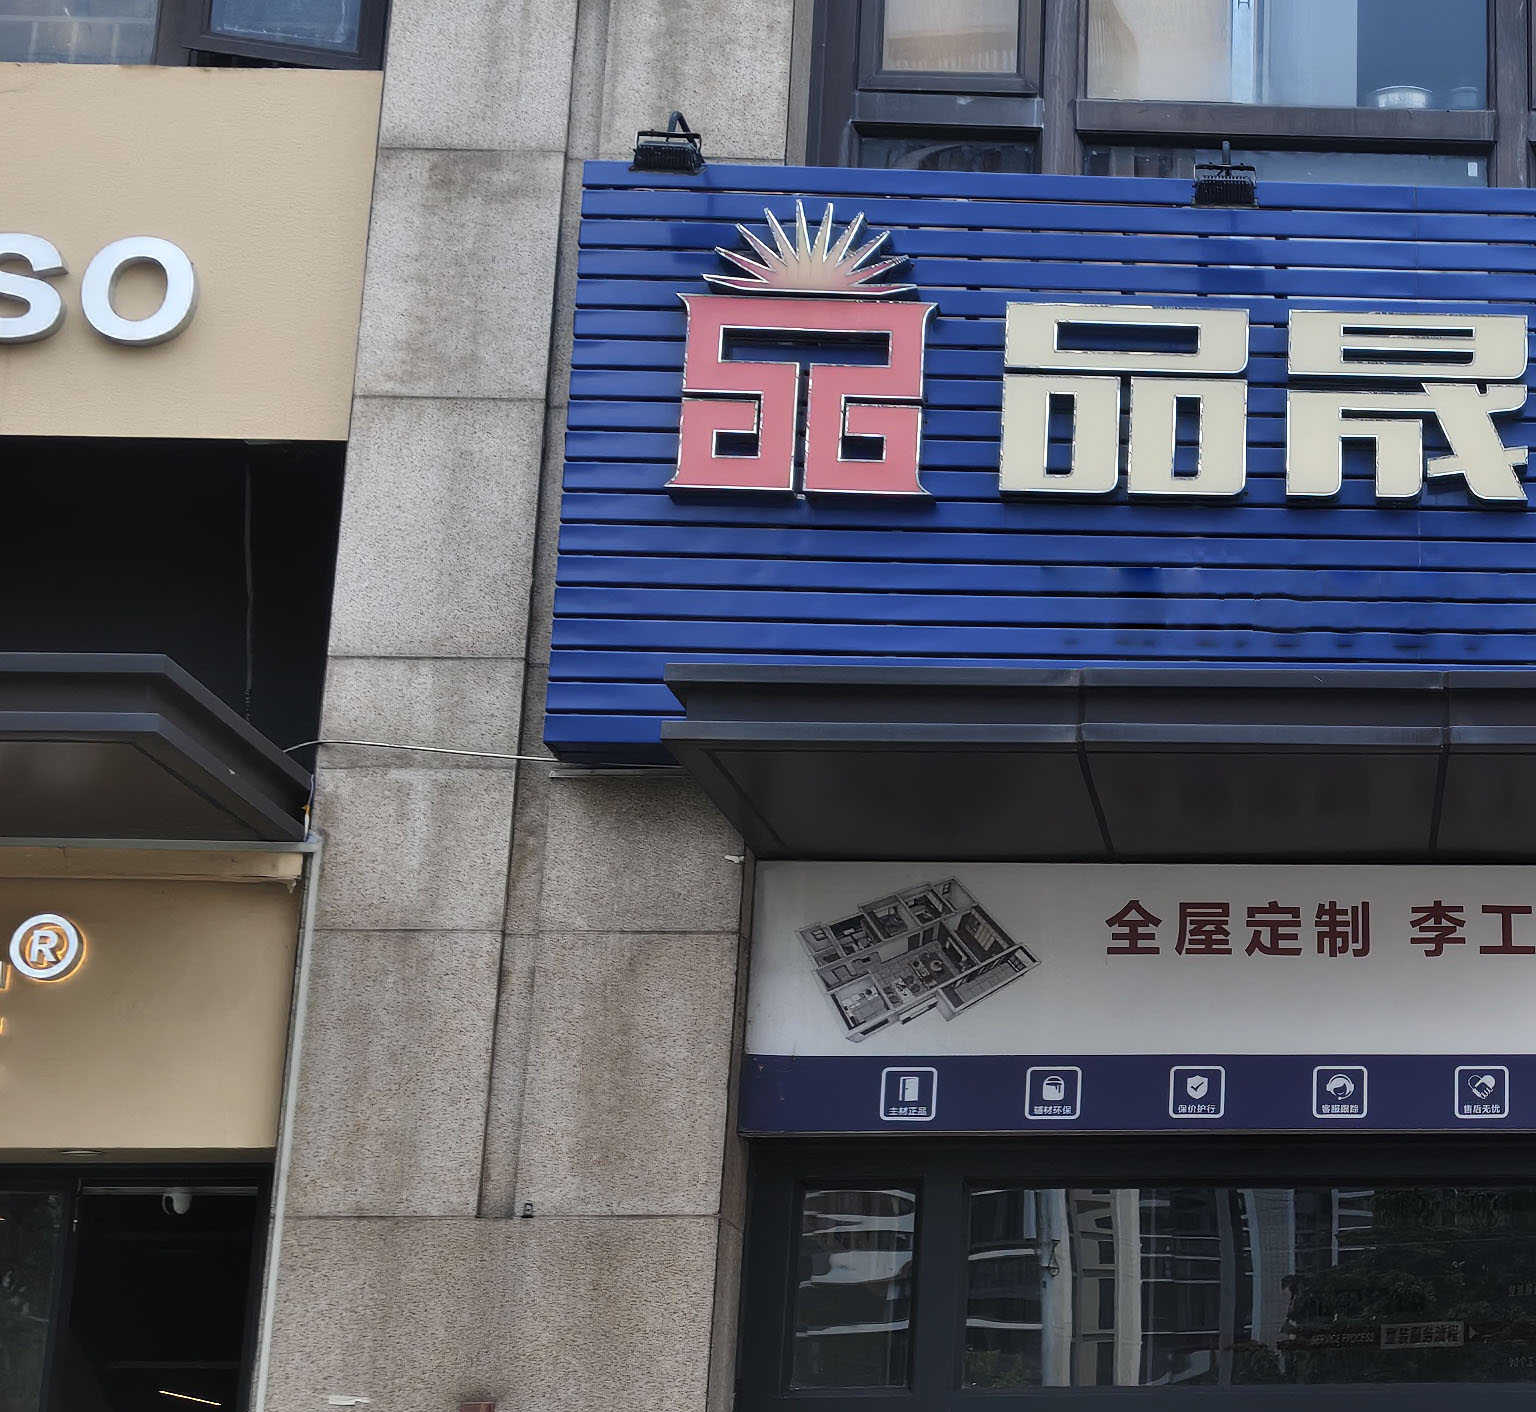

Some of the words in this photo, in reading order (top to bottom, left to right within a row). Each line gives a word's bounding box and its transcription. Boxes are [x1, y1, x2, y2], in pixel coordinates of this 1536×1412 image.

[1105, 899, 1370, 958] 全屋定制
[1410, 899, 1536, 958] 李工
[1463, 1104, 1501, 1115] 售后无忧
